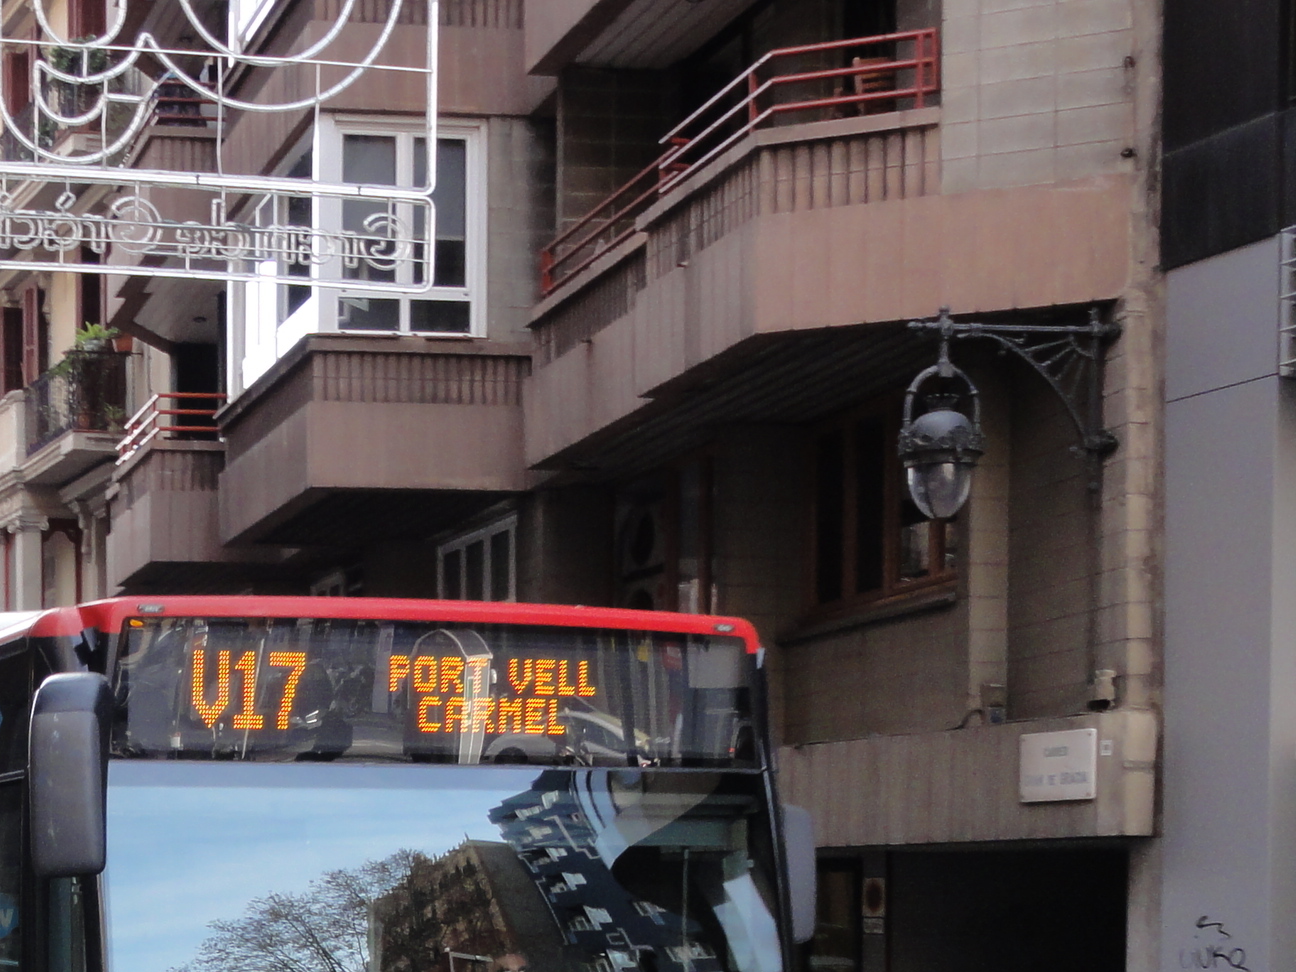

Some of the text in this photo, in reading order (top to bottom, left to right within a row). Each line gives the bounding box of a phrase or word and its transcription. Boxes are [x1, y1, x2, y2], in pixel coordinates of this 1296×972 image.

[190, 648, 306, 730] V17
[388, 654, 596, 697] PORT VELL
[416, 695, 565, 735] CARMEL
